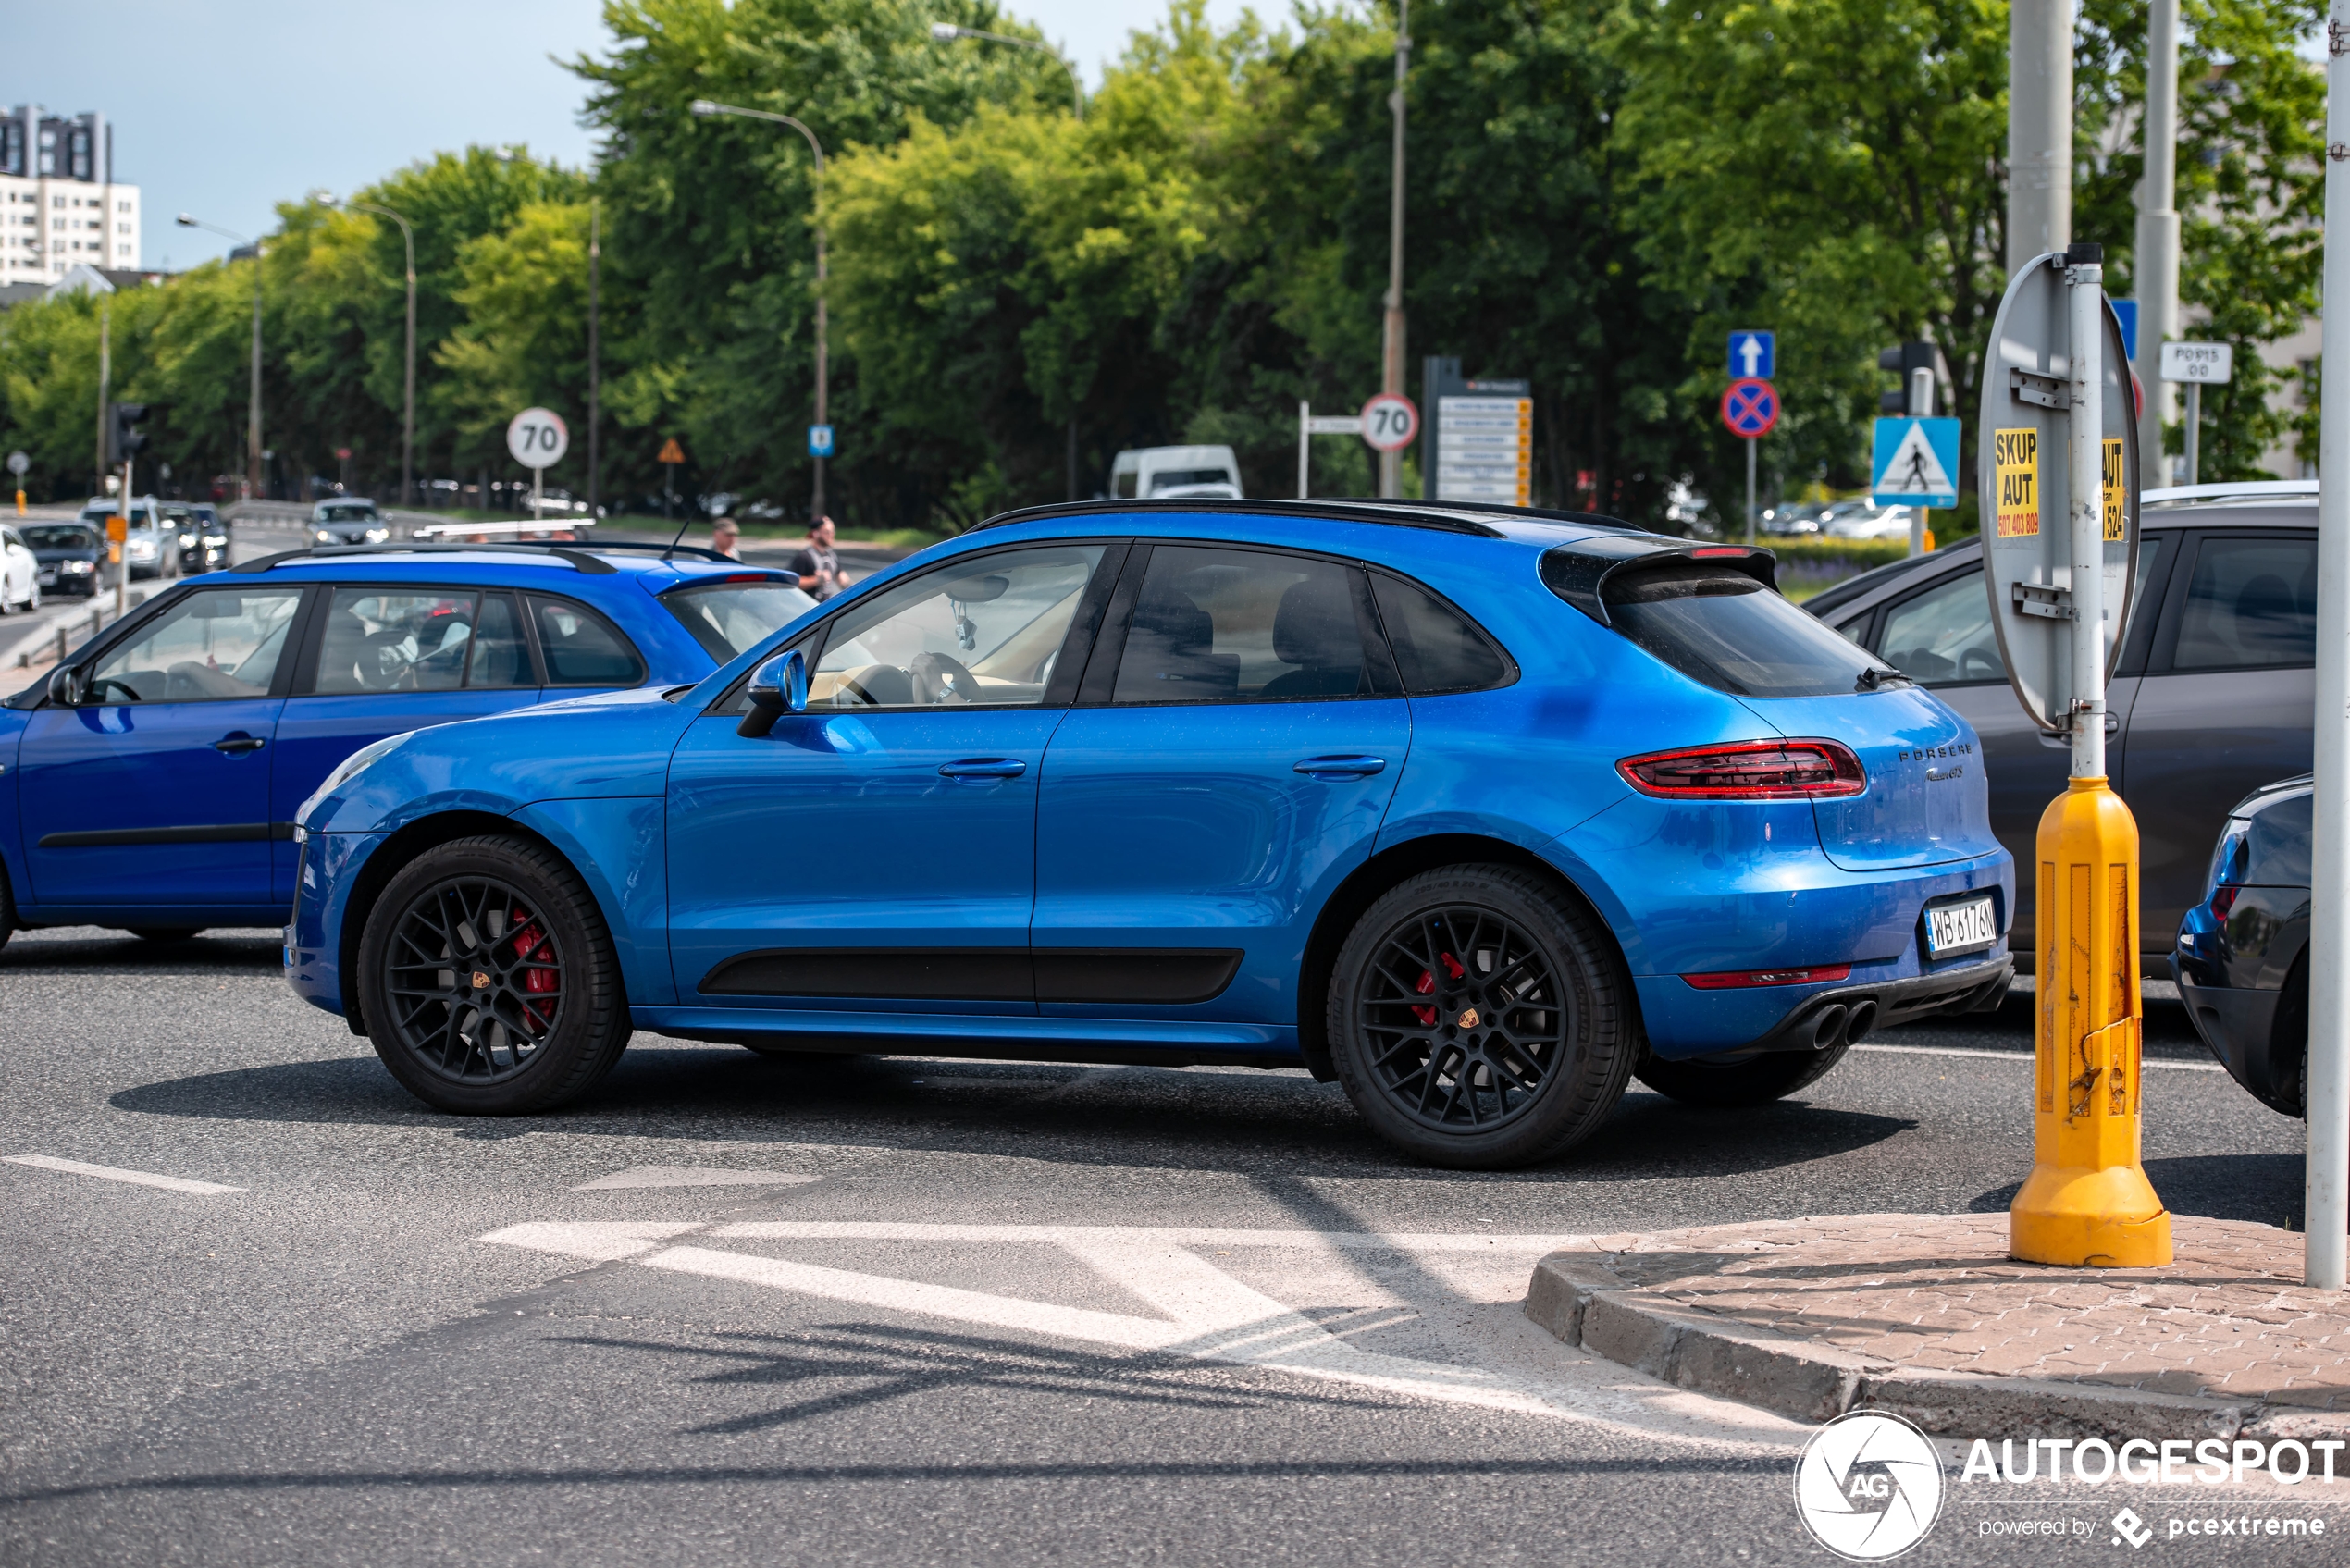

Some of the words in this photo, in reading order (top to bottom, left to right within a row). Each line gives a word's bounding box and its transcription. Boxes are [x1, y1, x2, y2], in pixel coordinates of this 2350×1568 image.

[1374, 408, 1410, 435] 70
[520, 424, 558, 451] 70
[1997, 433, 2036, 466] SKUP
[2003, 473, 2033, 506] AUT
[1998, 514, 2010, 537] 507
[2012, 513, 2025, 535] 403
[2026, 512, 2038, 535] 809
[1899, 743, 1973, 763] PORSCHE
[1933, 910, 1954, 946] WB
[1958, 903, 1994, 942] 6176N
[1333, 996, 1352, 1075] MICHELIN
